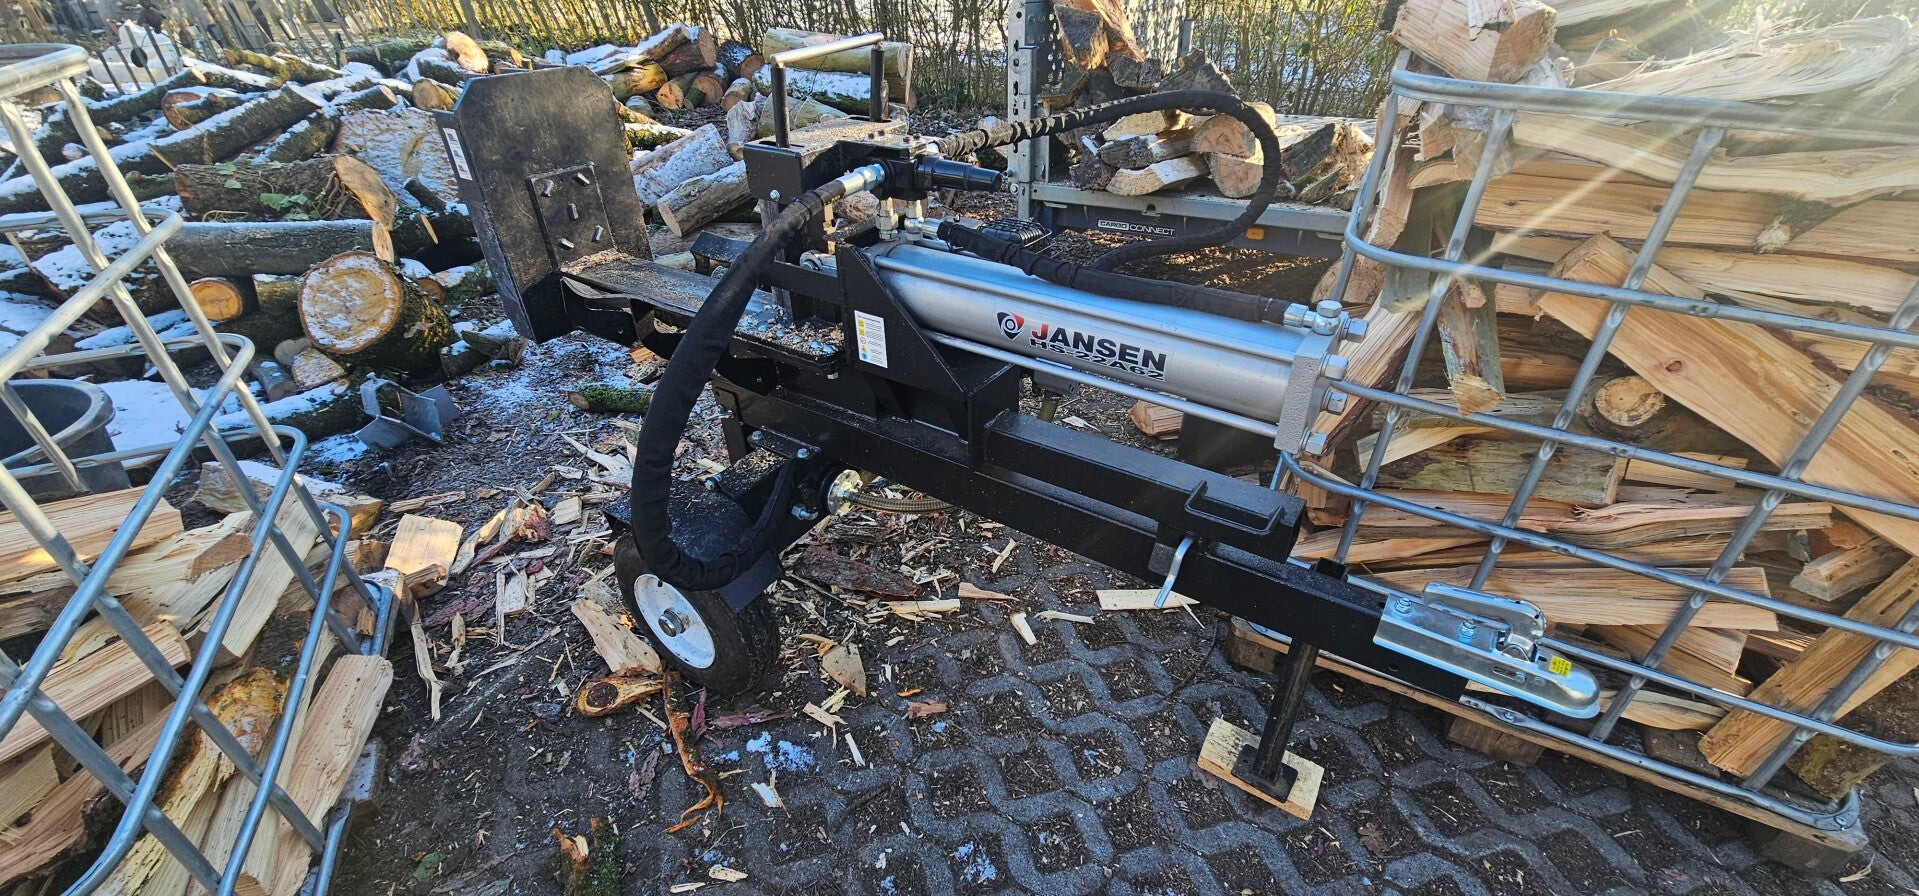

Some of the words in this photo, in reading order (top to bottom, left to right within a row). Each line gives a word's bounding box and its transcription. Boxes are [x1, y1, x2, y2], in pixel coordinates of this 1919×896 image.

[1099, 220, 1128, 230] CARGO
[1129, 224, 1176, 236] CONNECT
[1029, 338, 1165, 381] HS-22A62
[1031, 323, 1167, 372] JANSEN
